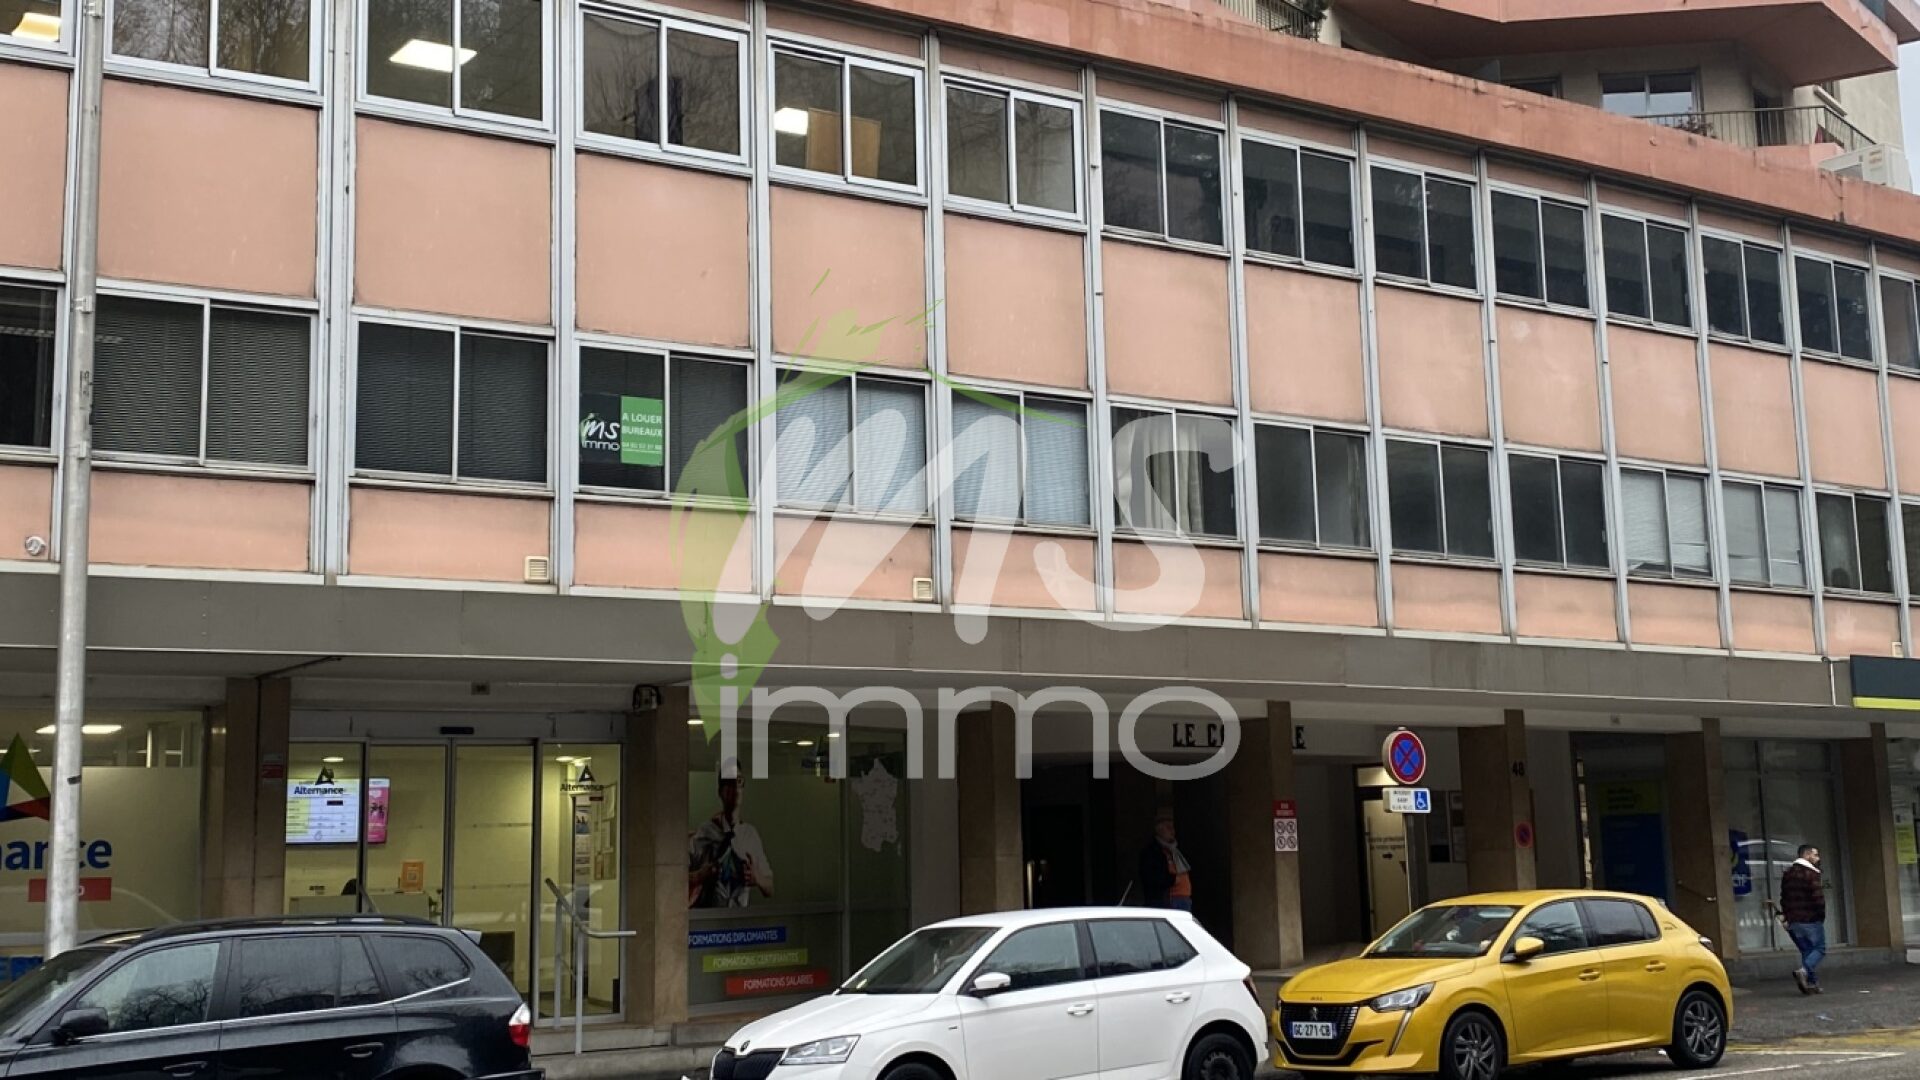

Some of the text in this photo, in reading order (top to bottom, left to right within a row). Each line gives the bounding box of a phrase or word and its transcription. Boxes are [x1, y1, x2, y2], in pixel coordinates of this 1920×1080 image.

[622, 413, 662, 424] A LOUER
[622, 426, 662, 437] BUREAUX
[294, 786, 344, 795] Alternance
[560, 784, 604, 792] Alternance
